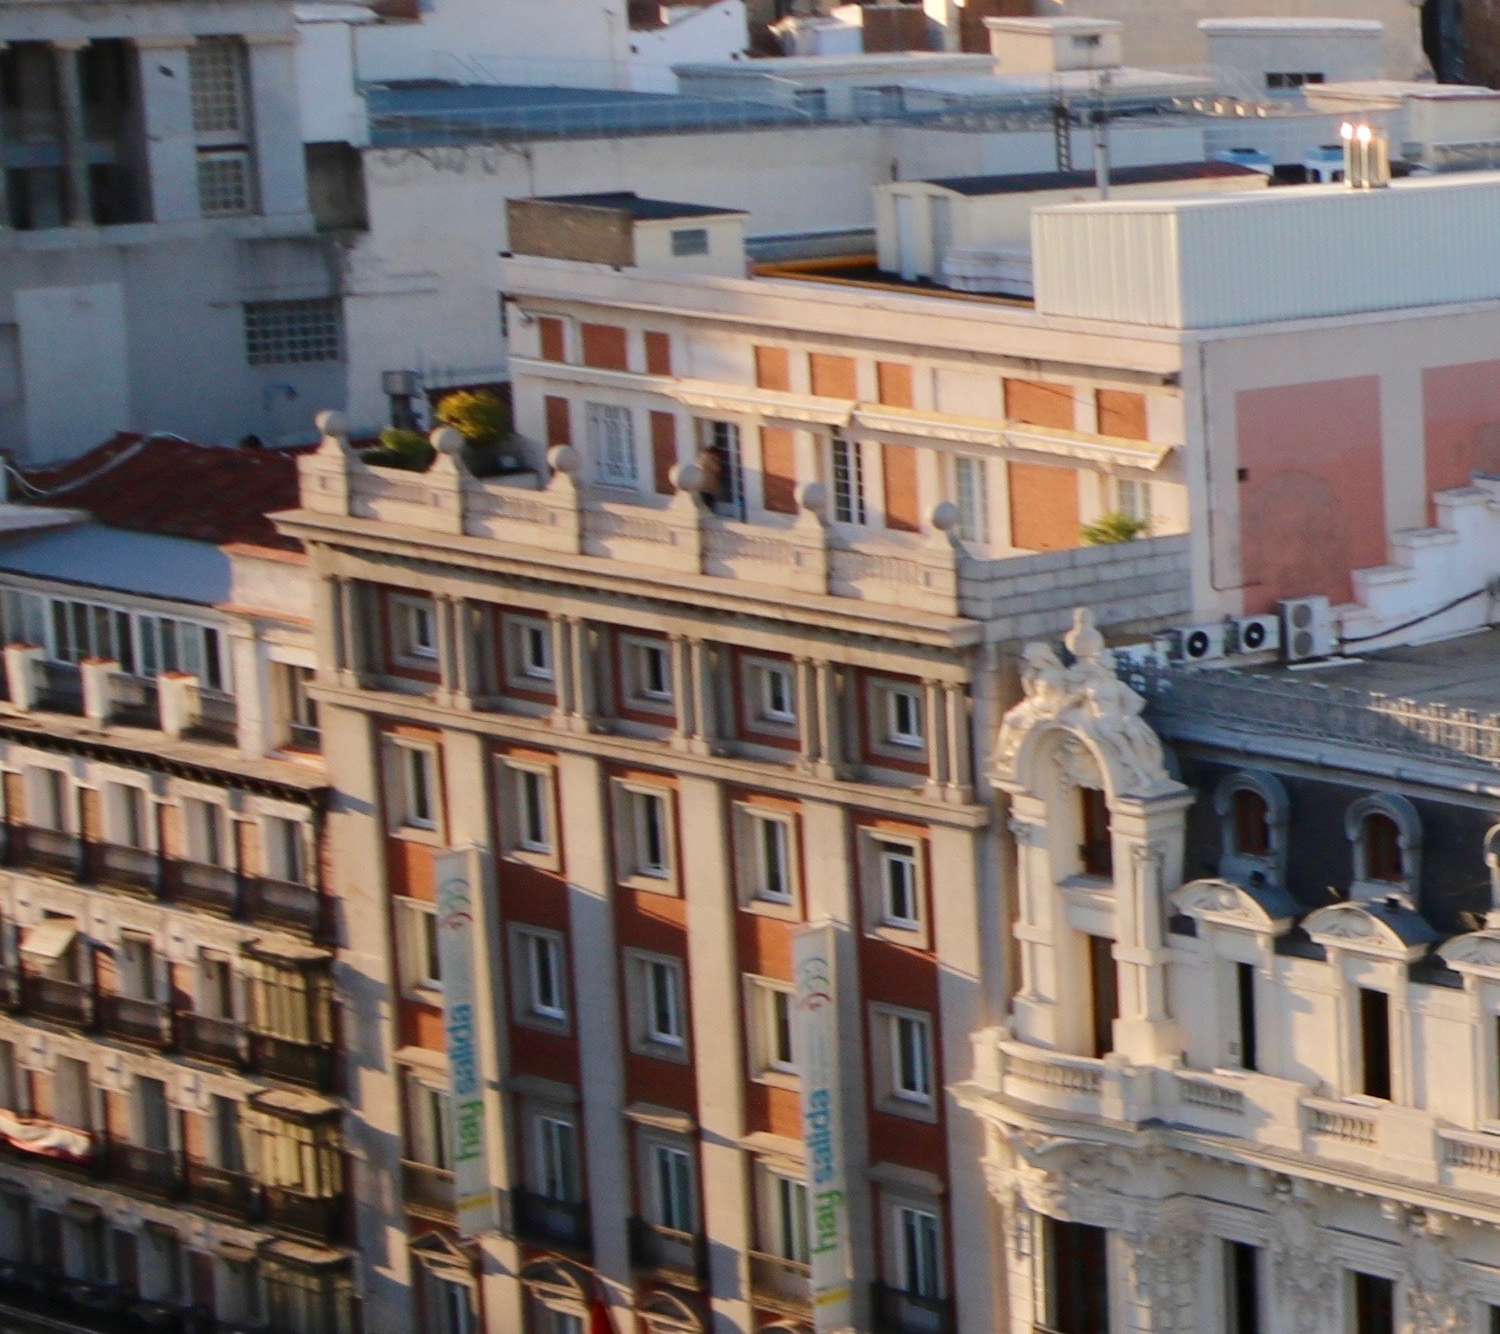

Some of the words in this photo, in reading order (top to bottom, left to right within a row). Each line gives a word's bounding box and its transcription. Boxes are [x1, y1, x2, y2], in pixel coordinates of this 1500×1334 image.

[446, 1003, 478, 1098] salida
[455, 1100, 483, 1163] hay
[805, 1088, 832, 1183] salida
[812, 1190, 843, 1255] hay
